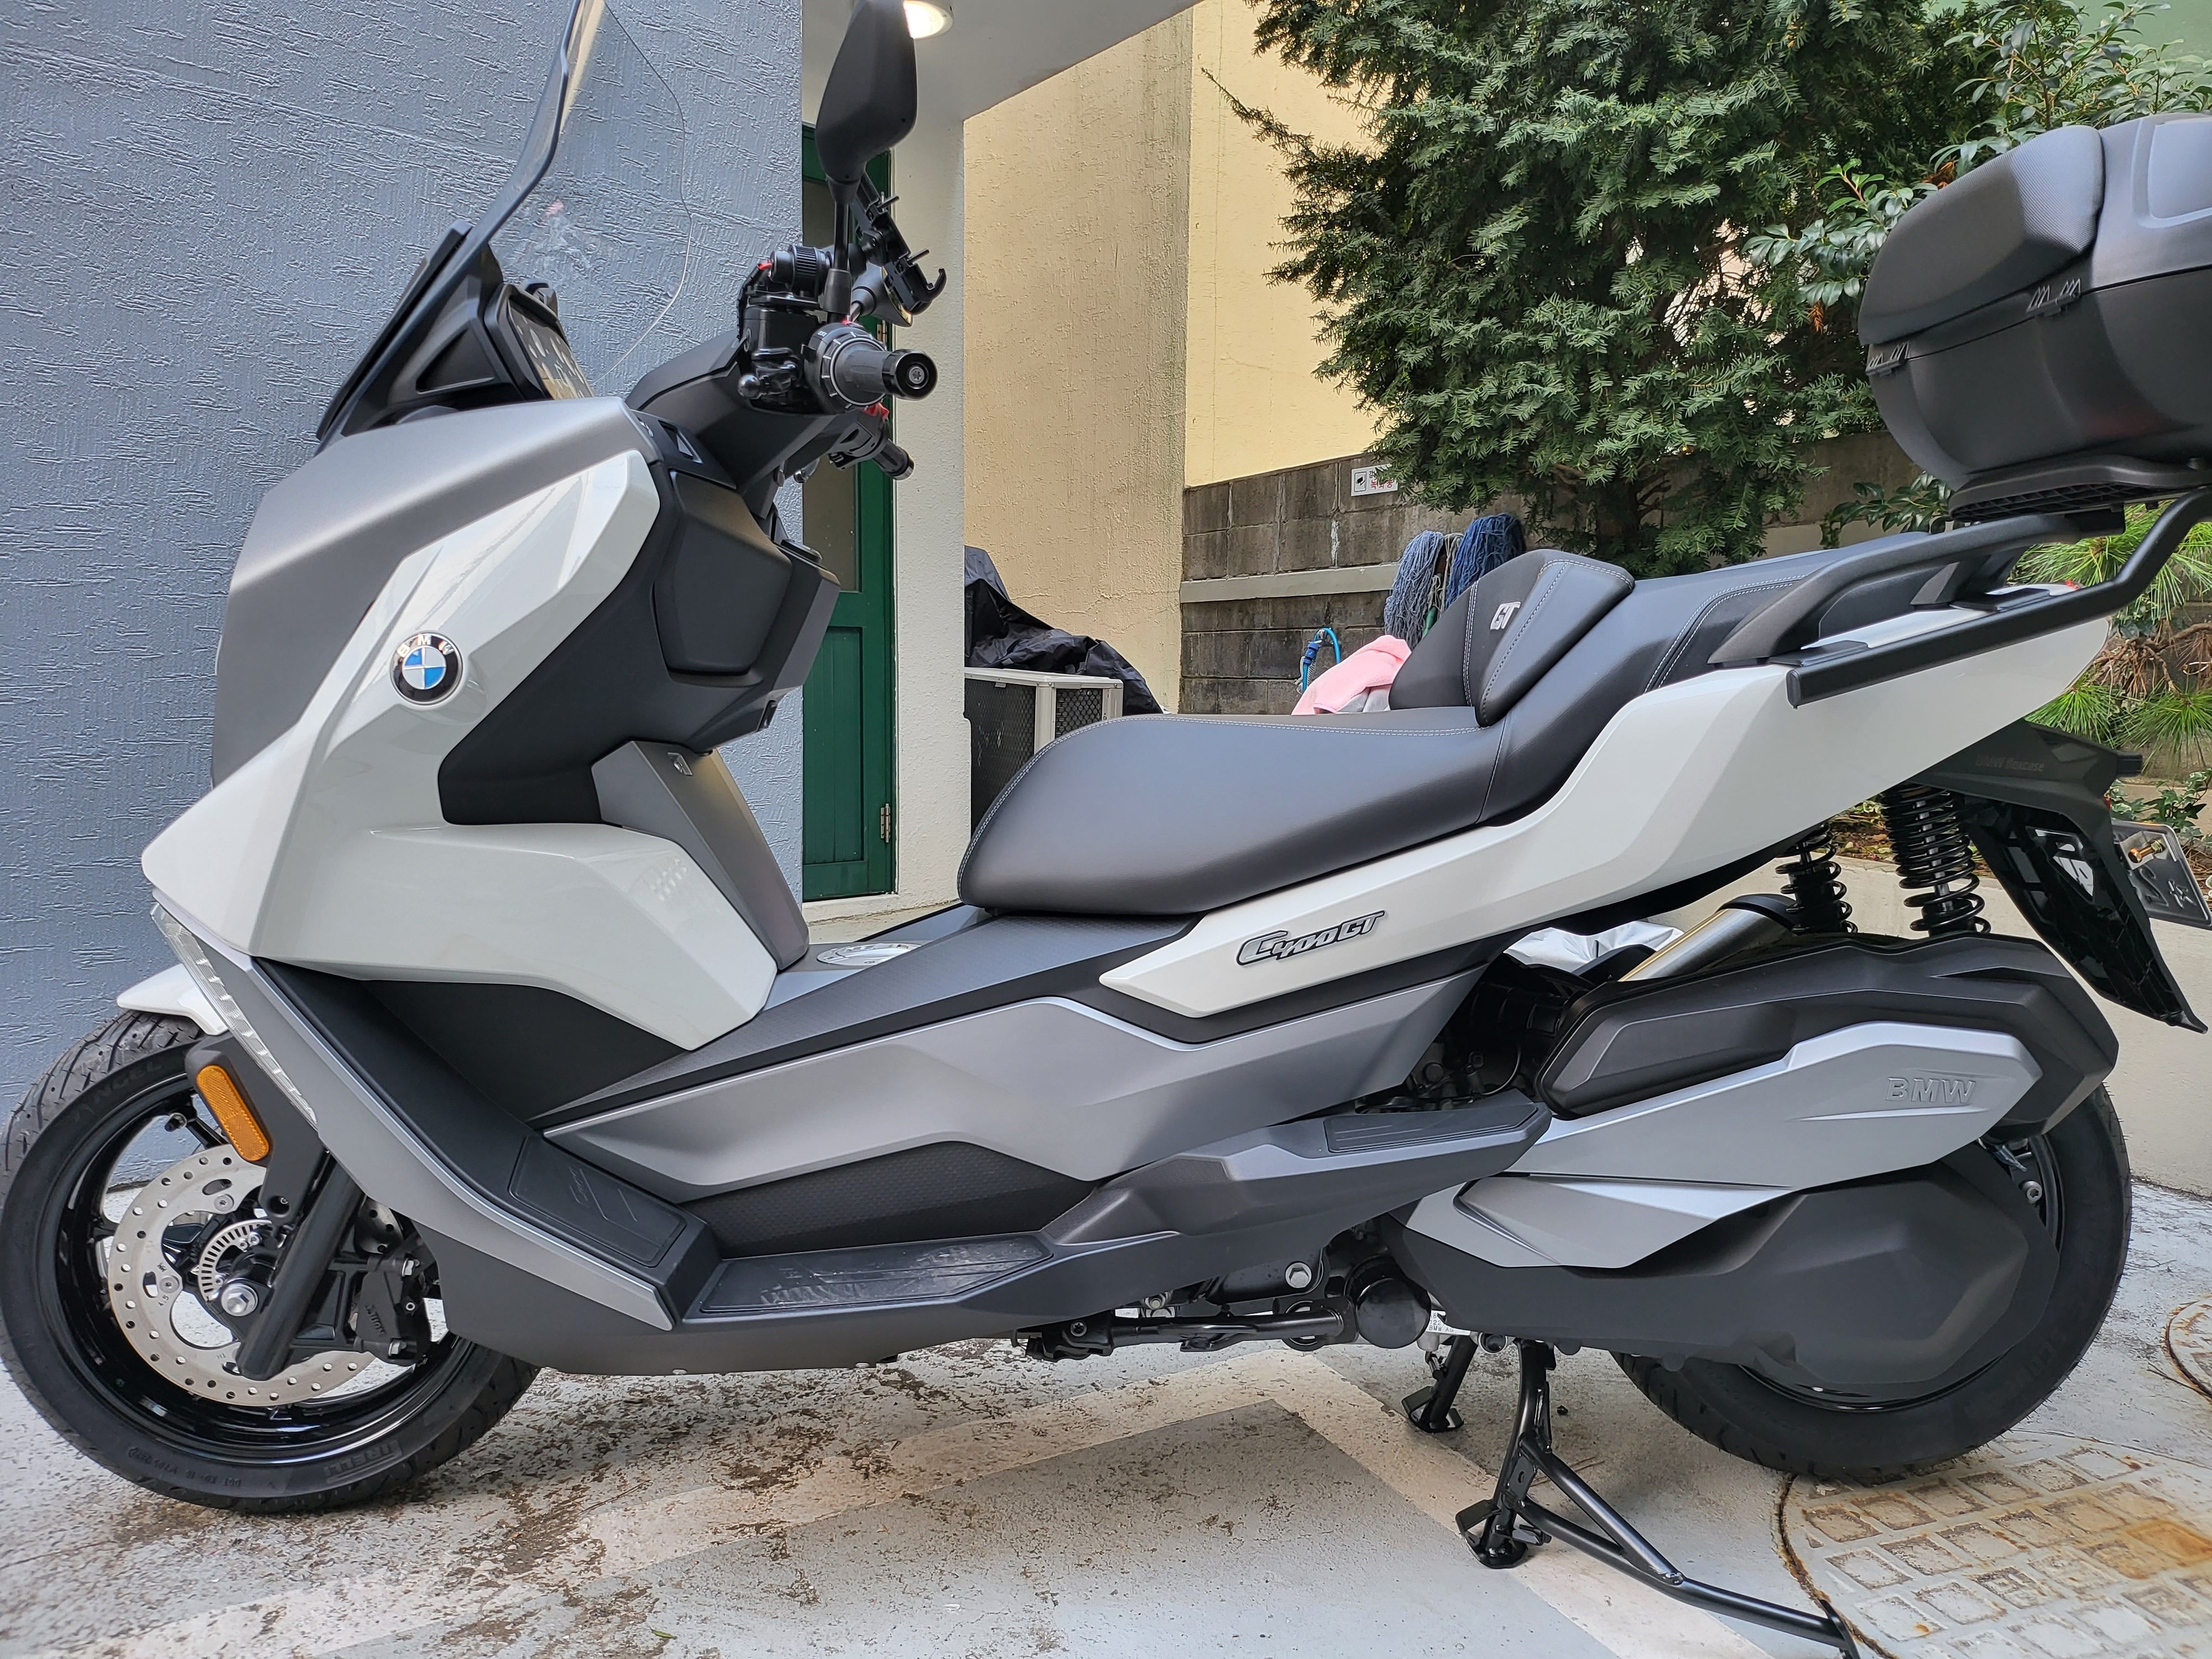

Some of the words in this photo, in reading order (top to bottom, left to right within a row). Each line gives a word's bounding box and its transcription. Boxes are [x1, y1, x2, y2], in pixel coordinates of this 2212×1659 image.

[1490, 601, 1522, 630] GT
[397, 634, 455, 658] BMW
[1237, 910, 1385, 966] C400GT
[1884, 1077, 1976, 1103] BMW
